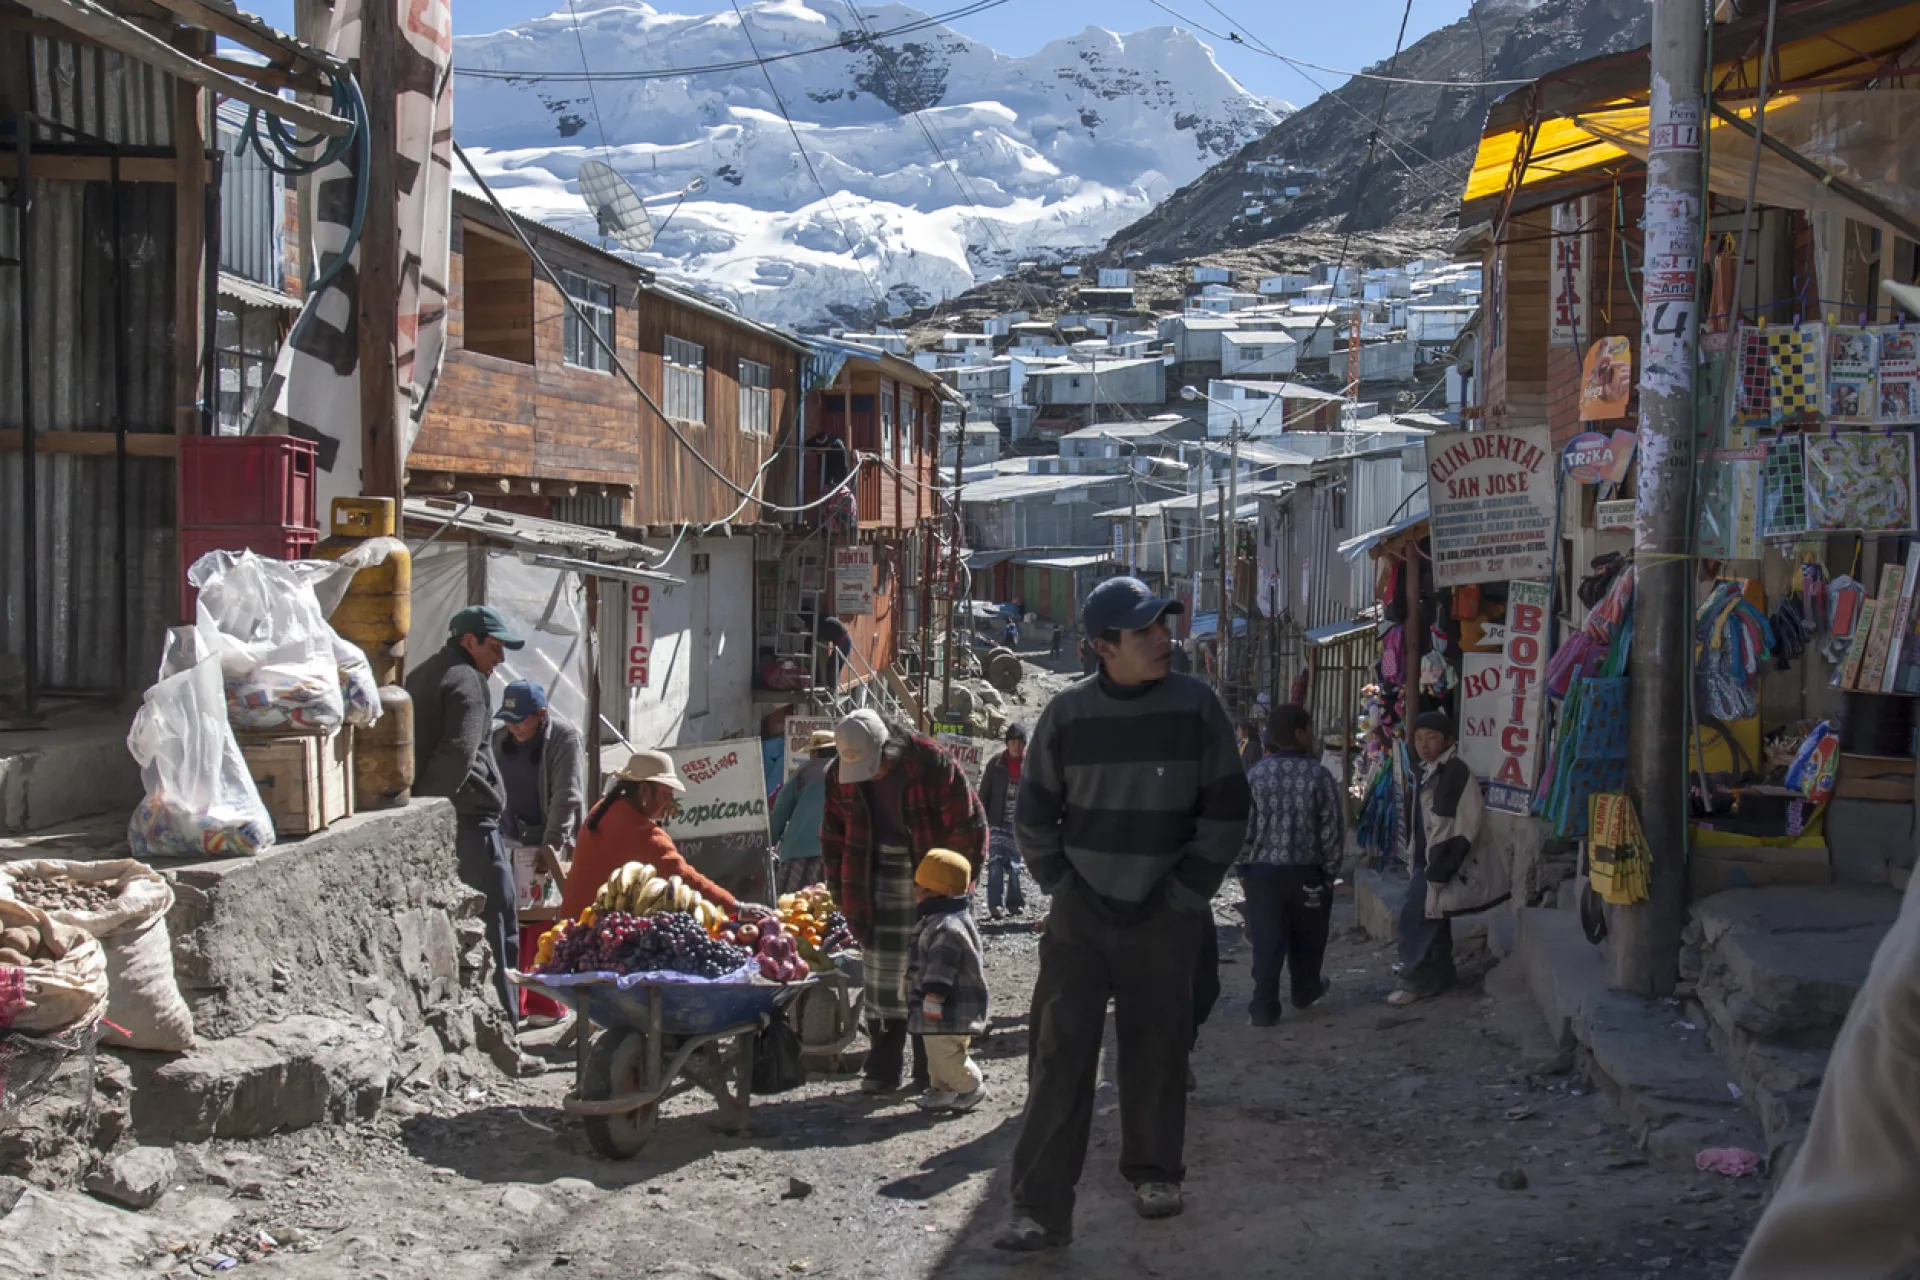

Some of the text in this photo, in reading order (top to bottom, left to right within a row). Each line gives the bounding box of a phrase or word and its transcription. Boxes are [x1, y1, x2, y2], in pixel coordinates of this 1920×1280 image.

[1556, 198, 1582, 326] NTAL
[1652, 302, 1688, 339] 4
[1472, 434, 1545, 474] DENTAL
[1447, 471, 1530, 500] SAN JOSE
[628, 566, 651, 685] OTICA
[1464, 667, 1502, 699] BO
[1493, 603, 1543, 788] BOTICA
